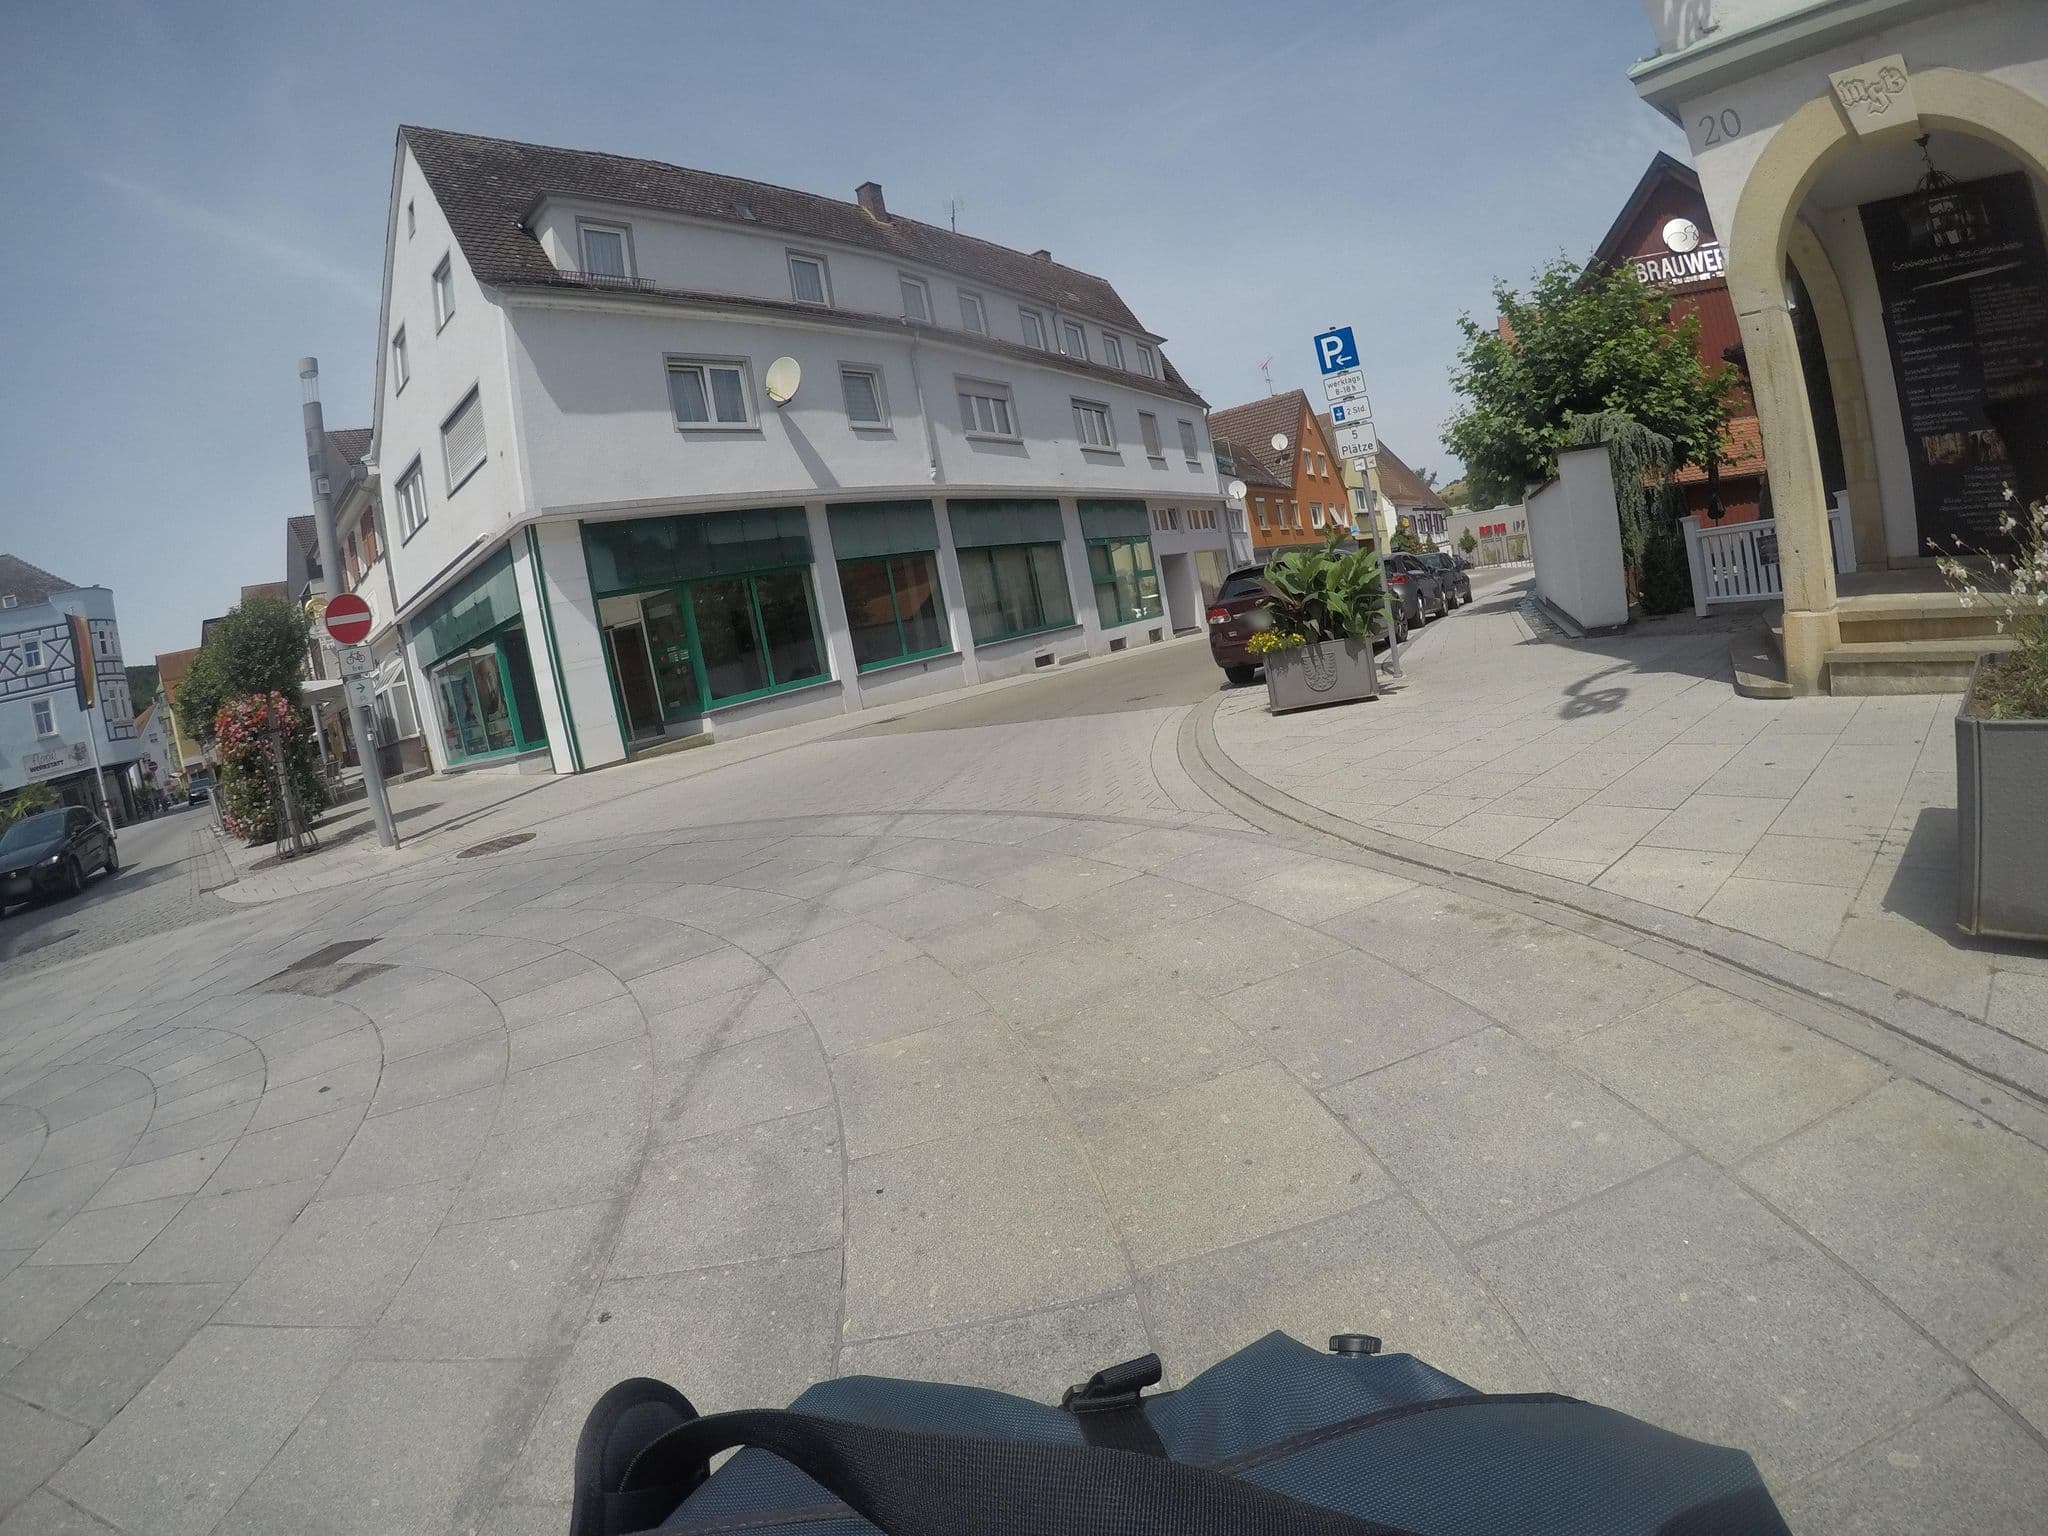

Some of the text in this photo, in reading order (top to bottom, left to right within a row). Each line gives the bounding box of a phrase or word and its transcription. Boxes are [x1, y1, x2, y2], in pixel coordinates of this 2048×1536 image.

[1698, 108, 1741, 146] 20
[1320, 335, 1344, 369] P
[1327, 376, 1361, 390] werktags
[1346, 407, 1352, 416] 2
[1351, 429, 1359, 440] 5
[1341, 442, 1374, 456] Plätze
